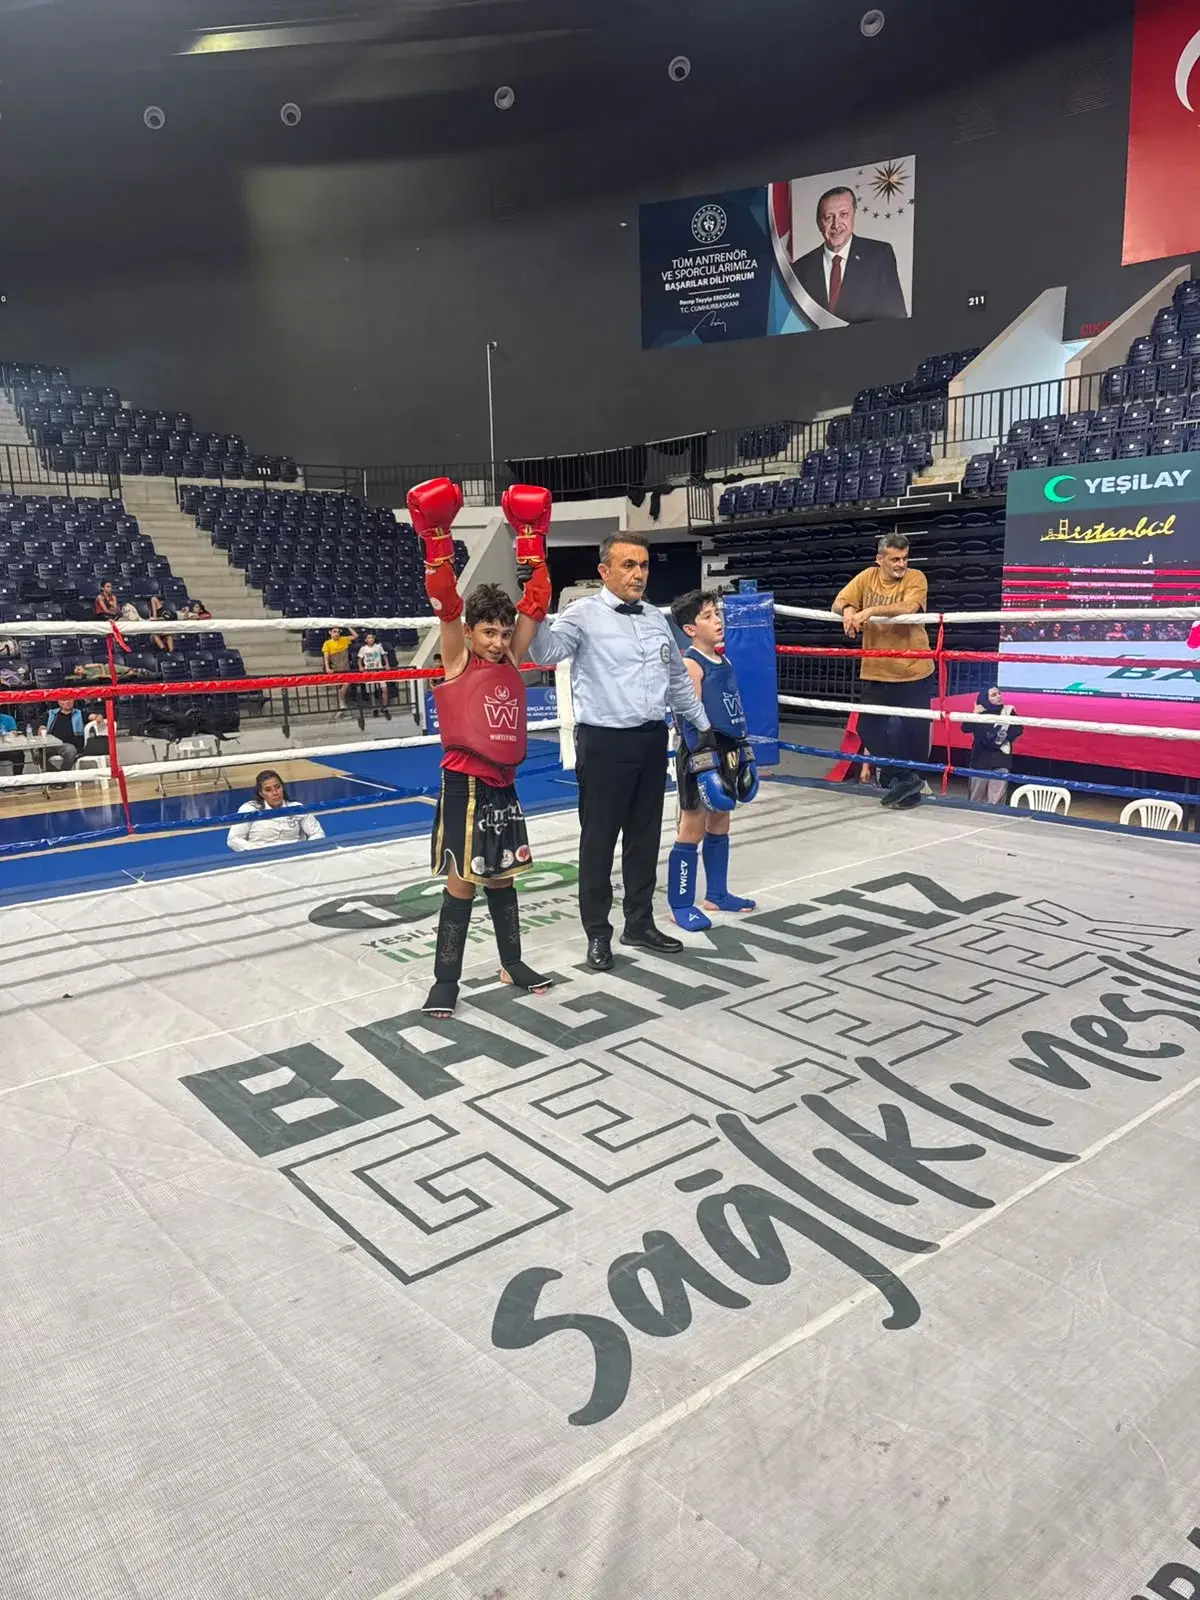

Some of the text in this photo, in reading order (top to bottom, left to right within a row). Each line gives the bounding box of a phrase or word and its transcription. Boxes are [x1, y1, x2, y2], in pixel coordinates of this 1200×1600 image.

[661, 258, 758, 281] VE SPORCULARIMIZA
[672, 249, 748, 269] TÜM ANTRENÖR
[664, 271, 755, 291] BAŞARILAR DİLİYORUM
[690, 300, 739, 312] CUMHURBAŞKANI
[968, 296, 985, 306] 211
[680, 860, 689, 896] ARIMA
[180, 871, 1021, 1157] BAĞIMSIZ
[279, 899, 1196, 1285] GELECEK
